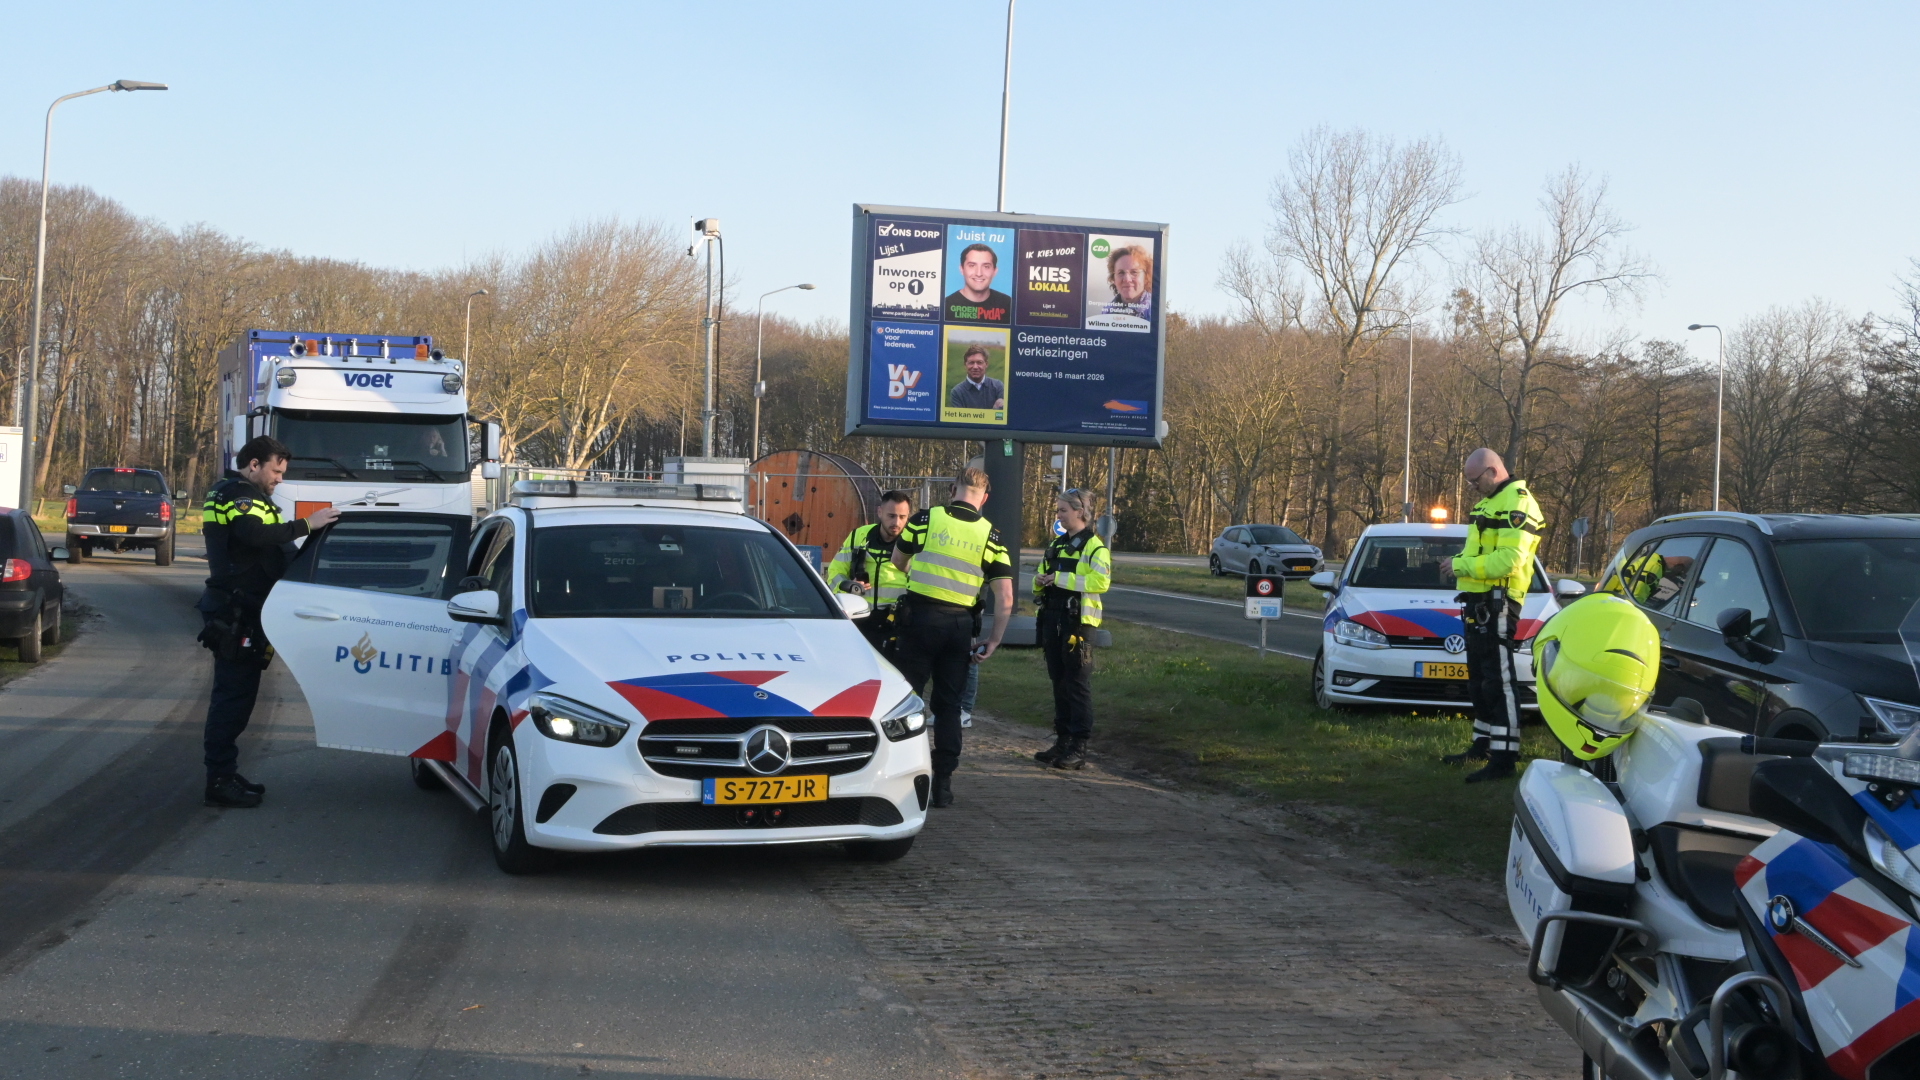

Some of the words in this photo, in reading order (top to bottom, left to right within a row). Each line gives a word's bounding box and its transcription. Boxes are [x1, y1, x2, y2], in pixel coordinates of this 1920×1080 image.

[891, 228, 912, 237] ONS
[914, 229, 940, 239] DORP
[956, 230, 986, 242] Juist
[988, 233, 1005, 243] nu
[879, 244, 899, 256] Lijst
[899, 242, 905, 252] 1
[1025, 251, 1034, 259] IK
[1037, 248, 1054, 258] KIES
[1055, 246, 1076, 256] VOOR
[878, 265, 937, 279] Inwoners
[1029, 265, 1071, 283] KIES
[889, 281, 906, 292] op
[1028, 282, 1071, 293] LOKAAL
[950, 305, 978, 313] GROEN
[954, 311, 978, 319] LINKS
[977, 306, 1002, 320] PvdA
[884, 326, 934, 336] Ondernemend
[1088, 320, 1110, 328] Wilma
[1111, 321, 1148, 330] Grooteman
[1017, 331, 1107, 347] Gemeenteraads
[1017, 346, 1089, 361] verkiezingen
[343, 372, 394, 389] voet
[887, 363, 922, 399] VVD
[1015, 371, 1052, 380] woensdag
[1054, 371, 1063, 379] 18
[1086, 373, 1105, 381] 2026
[907, 389, 930, 398] Bergen
[944, 410, 957, 418] Het
[972, 411, 985, 419] wél
[931, 532, 982, 553] POLITIE
[1259, 583, 1270, 591] 60
[349, 615, 394, 627] waakzaam
[394, 621, 406, 629] en
[406, 621, 453, 634] dienstbaar
[666, 652, 806, 663] POLITIE
[704, 793, 713, 801] NL
[724, 778, 816, 801] S-727-JR
[1512, 854, 1543, 920] POLITIE
